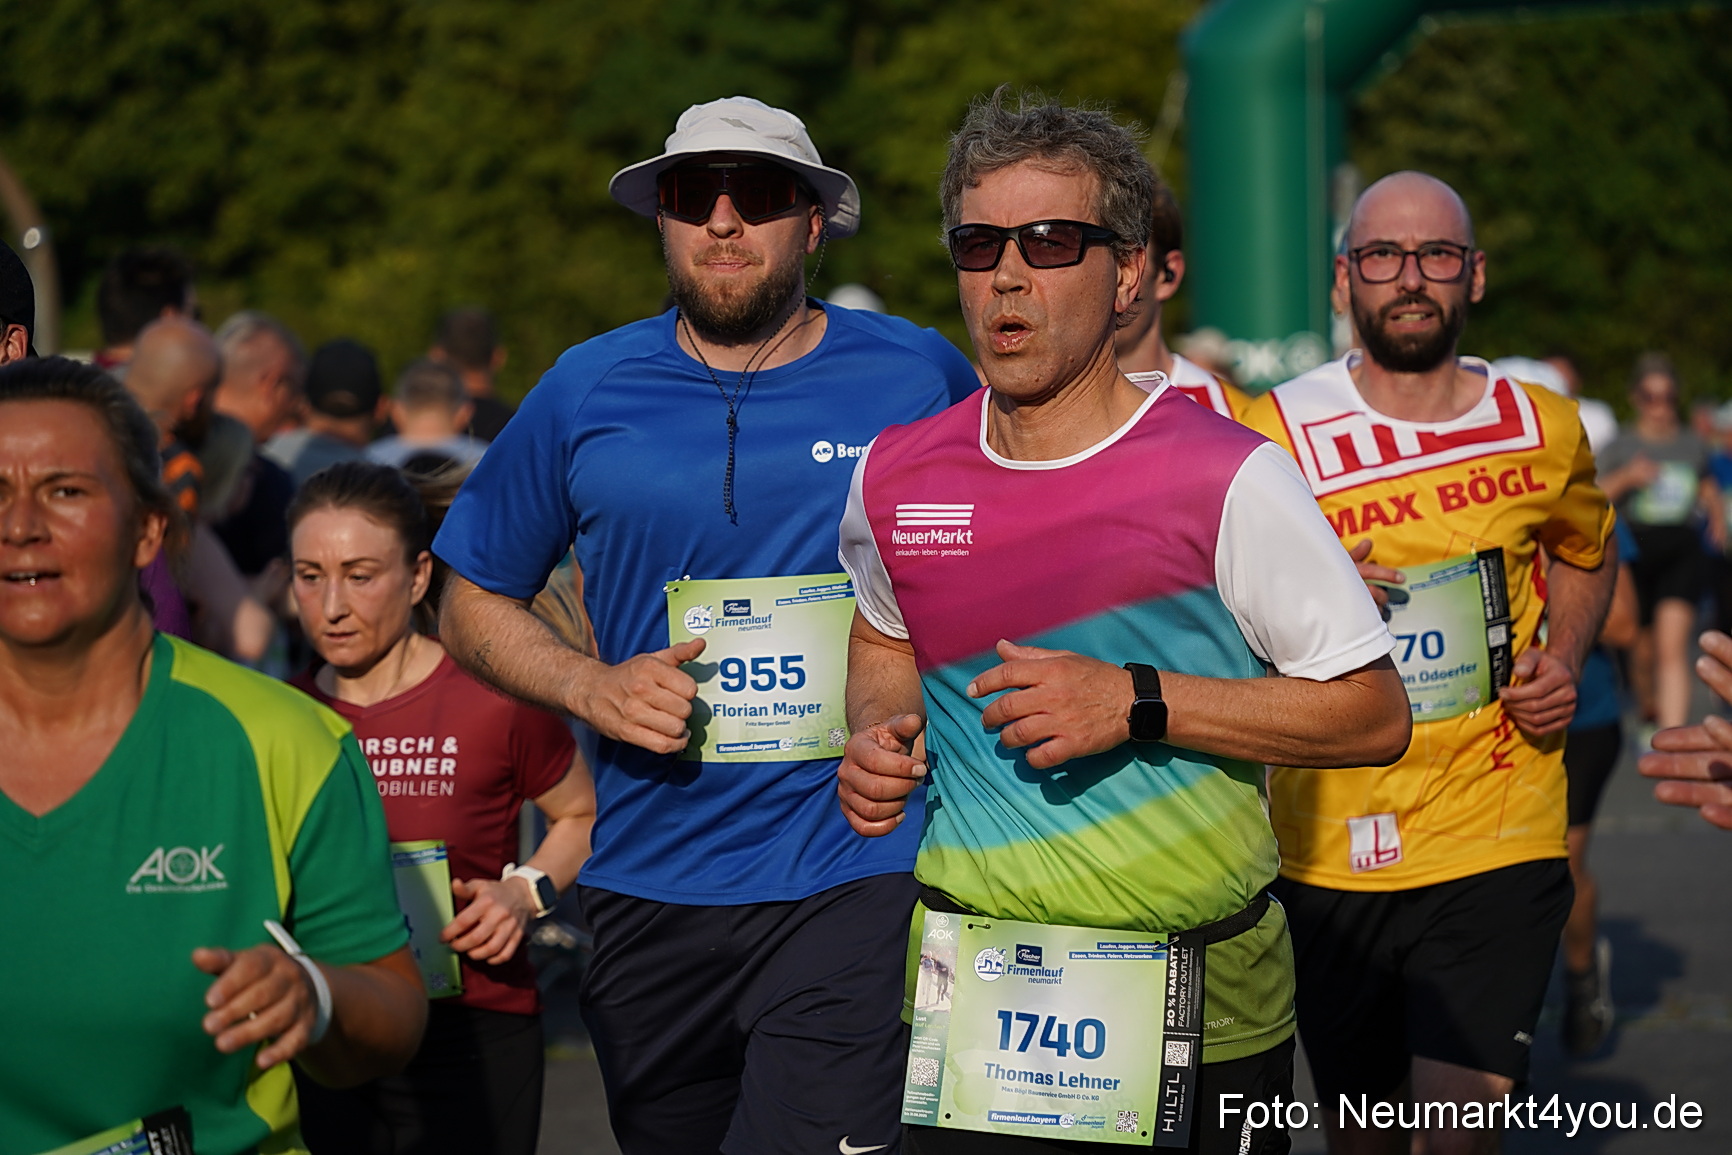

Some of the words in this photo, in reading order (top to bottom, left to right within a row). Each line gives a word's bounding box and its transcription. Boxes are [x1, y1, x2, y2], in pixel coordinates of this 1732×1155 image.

[1436, 466, 1547, 513] BÖGL
[892, 529, 973, 545] NeuerMarkt
[715, 613, 773, 628] Firmenlauf
[738, 623, 772, 632] neumarkt
[1395, 630, 1445, 663] 70
[719, 655, 806, 693] 955
[1420, 662, 1478, 682] Odoerfer
[712, 703, 768, 717] Florian
[773, 702, 822, 718] Mayer
[358, 736, 434, 755] IRSCH
[441, 736, 458, 754] &
[370, 757, 456, 776] UBNER
[377, 780, 455, 796] OBILIEN
[130, 843, 225, 883] AOK
[928, 929, 953, 940] AOK
[1007, 964, 1064, 978] Firmenlauf
[1168, 945, 1178, 996] RABATT
[1028, 976, 1062, 985] neumarkt
[1168, 998, 1176, 1007] %
[1178, 985, 1187, 1027] FACTORY
[1167, 1011, 1176, 1027] 20
[1203, 1017, 1235, 1030] TRADRY
[997, 1009, 1106, 1060] 1740
[984, 1062, 1054, 1086] Thomas
[1059, 1071, 1120, 1091] Lehner
[1028, 1089, 1058, 1098] Bauservice
[1058, 1092, 1075, 1100] GmbH
[1162, 1072, 1180, 1132] HILTL
[991, 1113, 1057, 1125] firmenlauf.bayern
